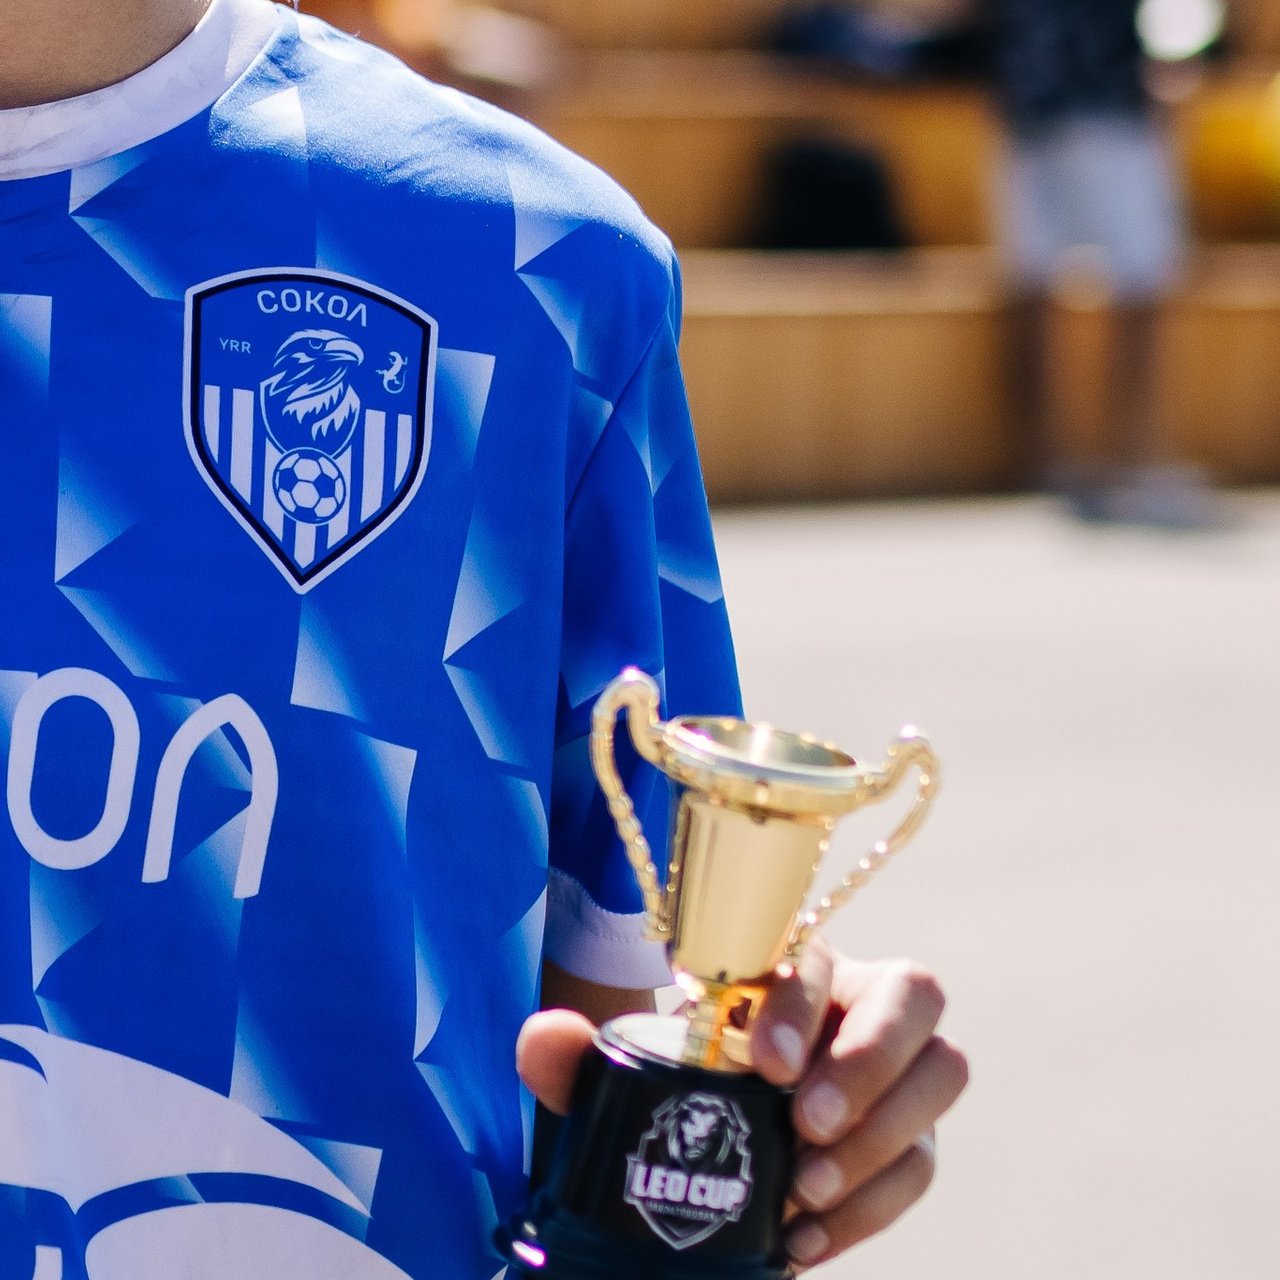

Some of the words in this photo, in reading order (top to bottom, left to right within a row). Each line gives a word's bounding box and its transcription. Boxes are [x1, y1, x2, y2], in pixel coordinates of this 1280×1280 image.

[257, 288, 368, 327] СОКОЛ
[219, 337, 252, 354] YRR
[631, 1162, 688, 1202] LEO
[687, 1173, 747, 1212] CUP
